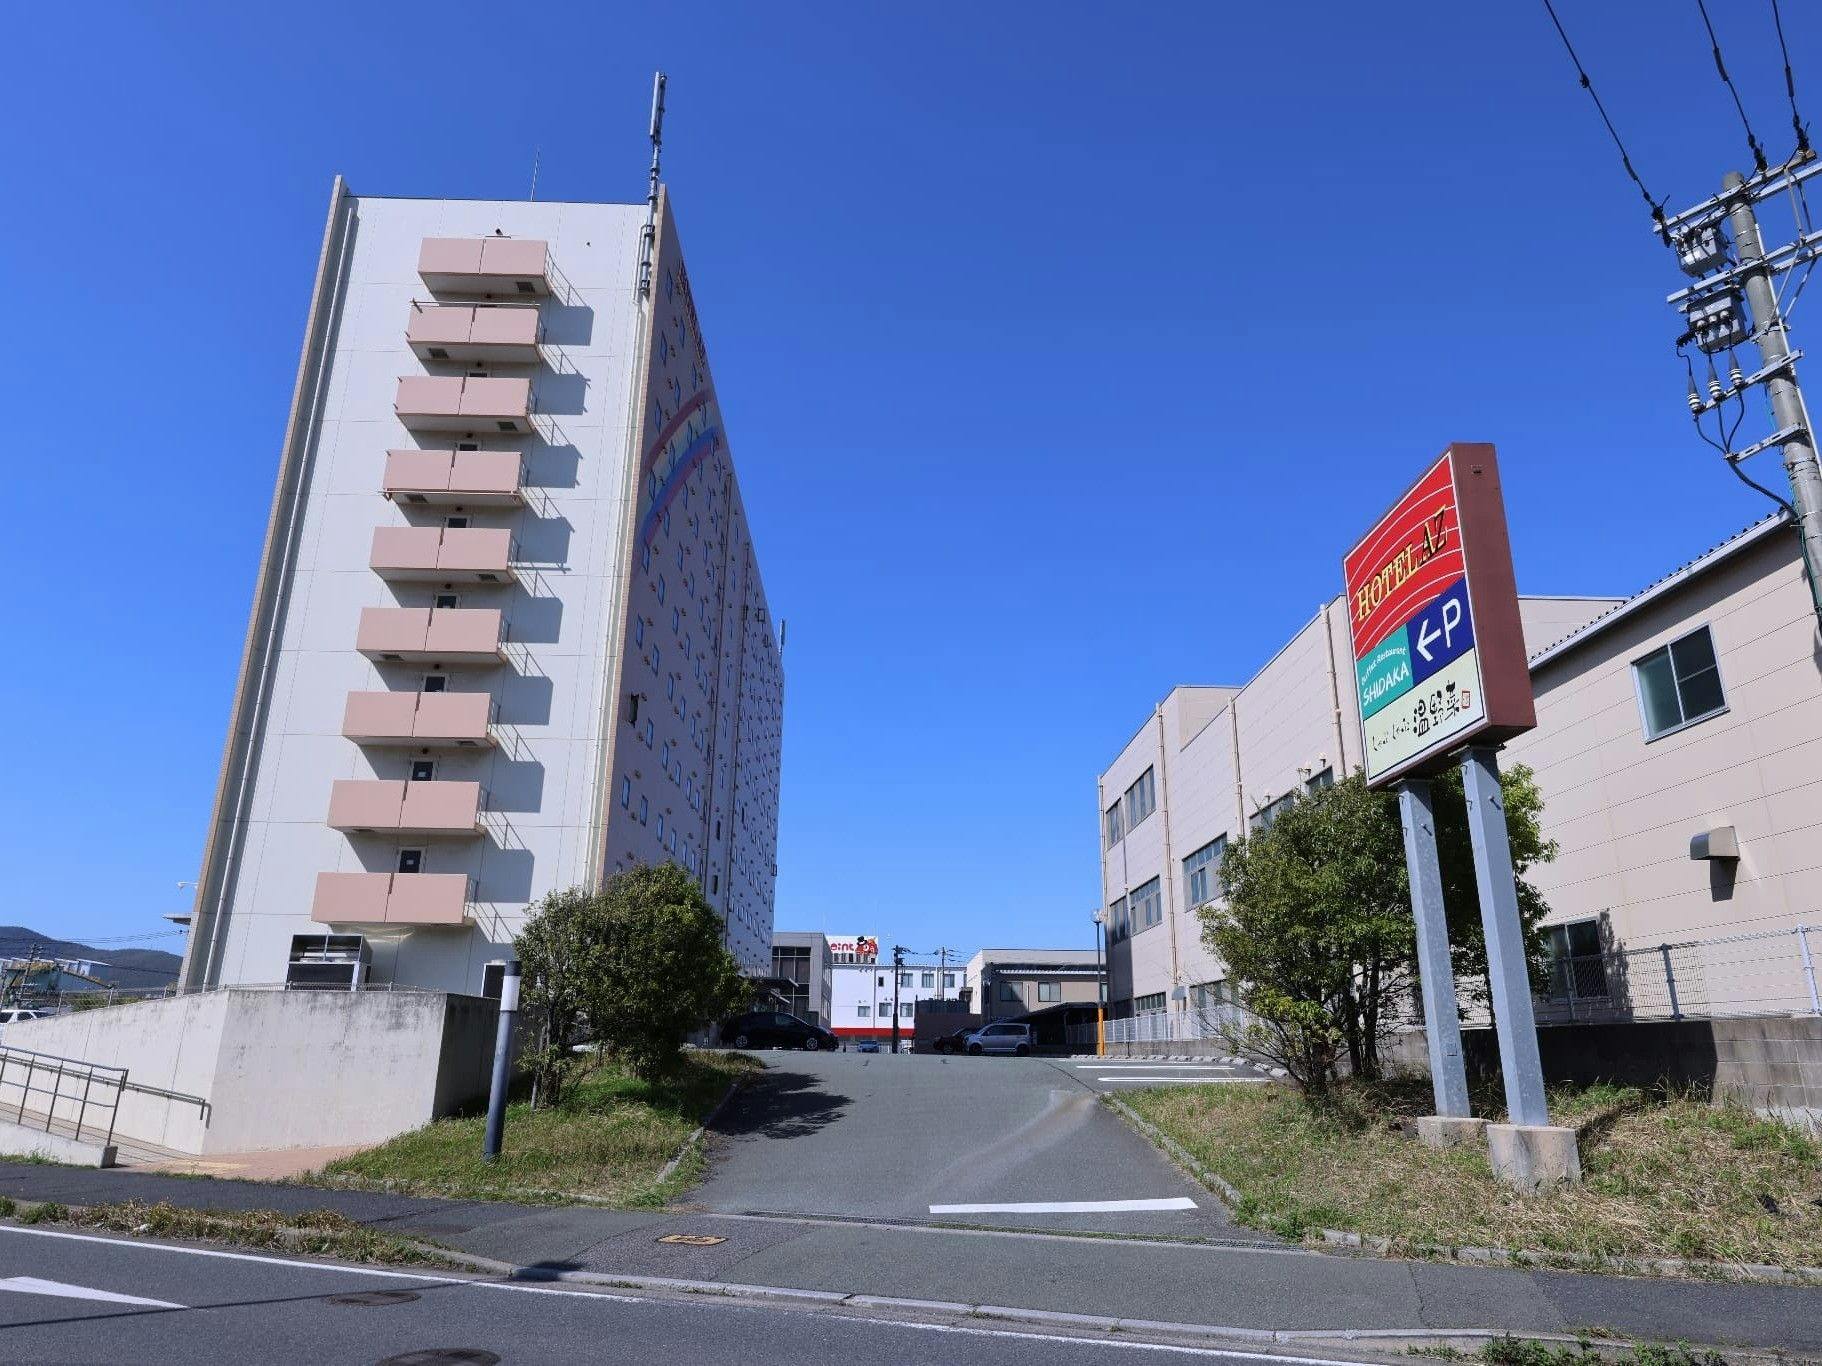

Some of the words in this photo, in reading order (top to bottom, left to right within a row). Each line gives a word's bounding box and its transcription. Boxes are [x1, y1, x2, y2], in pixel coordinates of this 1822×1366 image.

[1357, 543, 1419, 622] HOTEL
[1420, 504, 1448, 567] AZ
[1442, 598, 1461, 649] P
[1363, 660, 1410, 707] SHIDAKA
